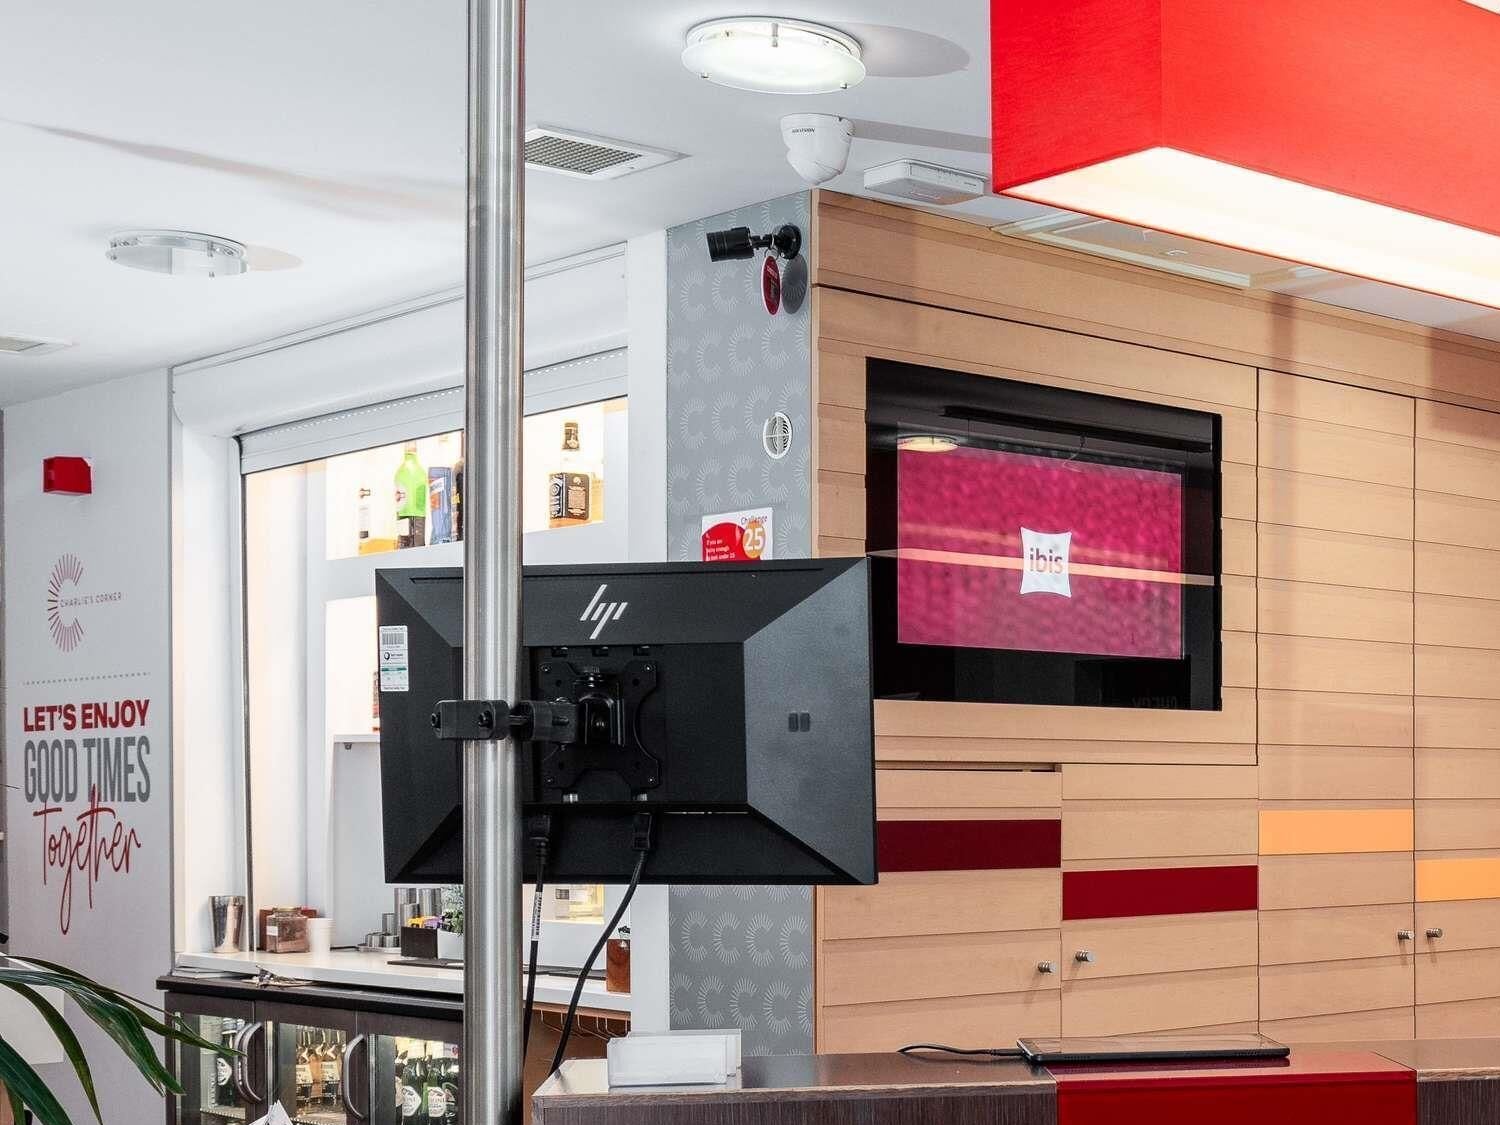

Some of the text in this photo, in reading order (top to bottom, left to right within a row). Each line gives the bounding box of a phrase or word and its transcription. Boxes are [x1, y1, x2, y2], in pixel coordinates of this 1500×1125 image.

[744, 528, 763, 551] 25
[1030, 548, 1063, 574] ibis
[23, 699, 150, 732] LET'S ENJOY
[24, 735, 150, 803] GOOD TIMES
